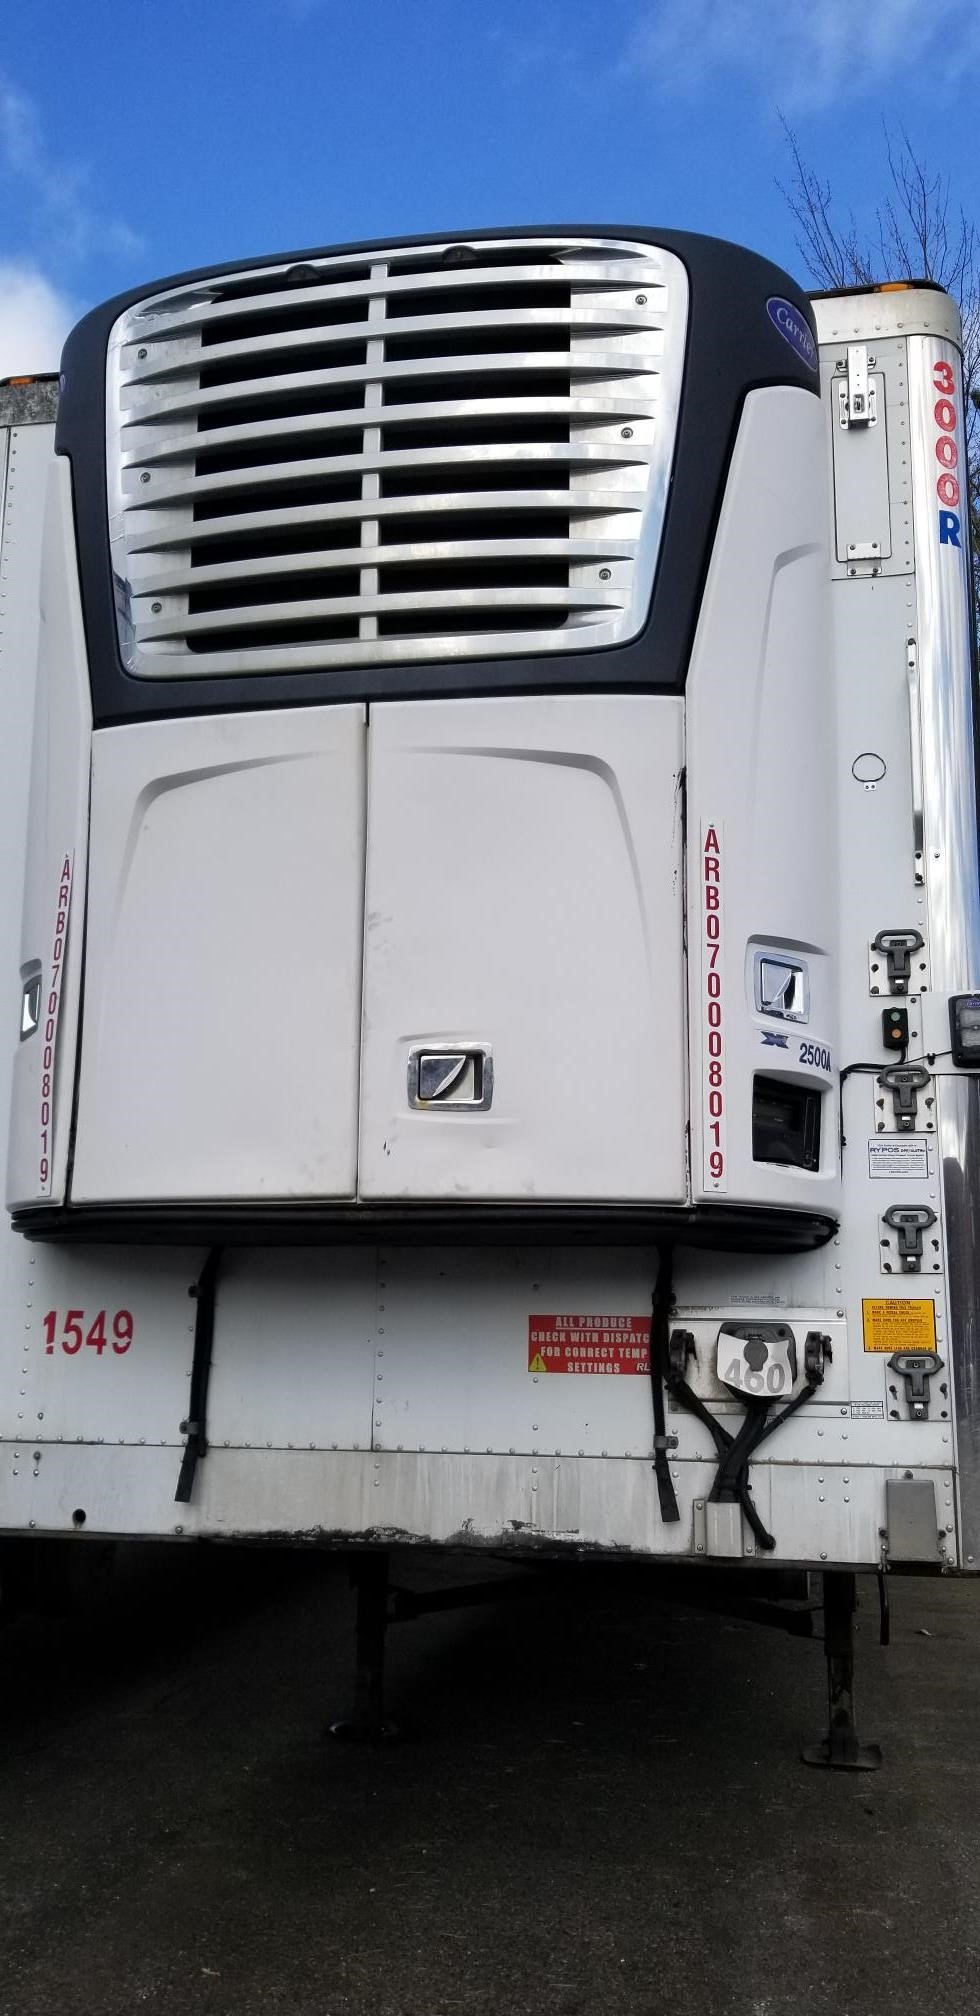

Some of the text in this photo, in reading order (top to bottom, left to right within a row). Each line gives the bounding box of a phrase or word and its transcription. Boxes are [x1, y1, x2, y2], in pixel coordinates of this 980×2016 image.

[776, 307, 815, 359] Carrier
[933, 361, 962, 549] 3000R
[39, 859, 71, 1183] ARB070008019
[704, 828, 723, 1179] ARB070008019
[799, 1042, 832, 1072] 2500A
[43, 1309, 134, 1355] 1549
[531, 1331, 651, 1344] CHECK WITH DISPATC
[555, 1316, 632, 1328] ALL PRODUCE
[540, 1346, 648, 1359] FOR CORRECT TEMP
[567, 1362, 621, 1373] SETTINGS
[724, 1358, 786, 1394] 460
